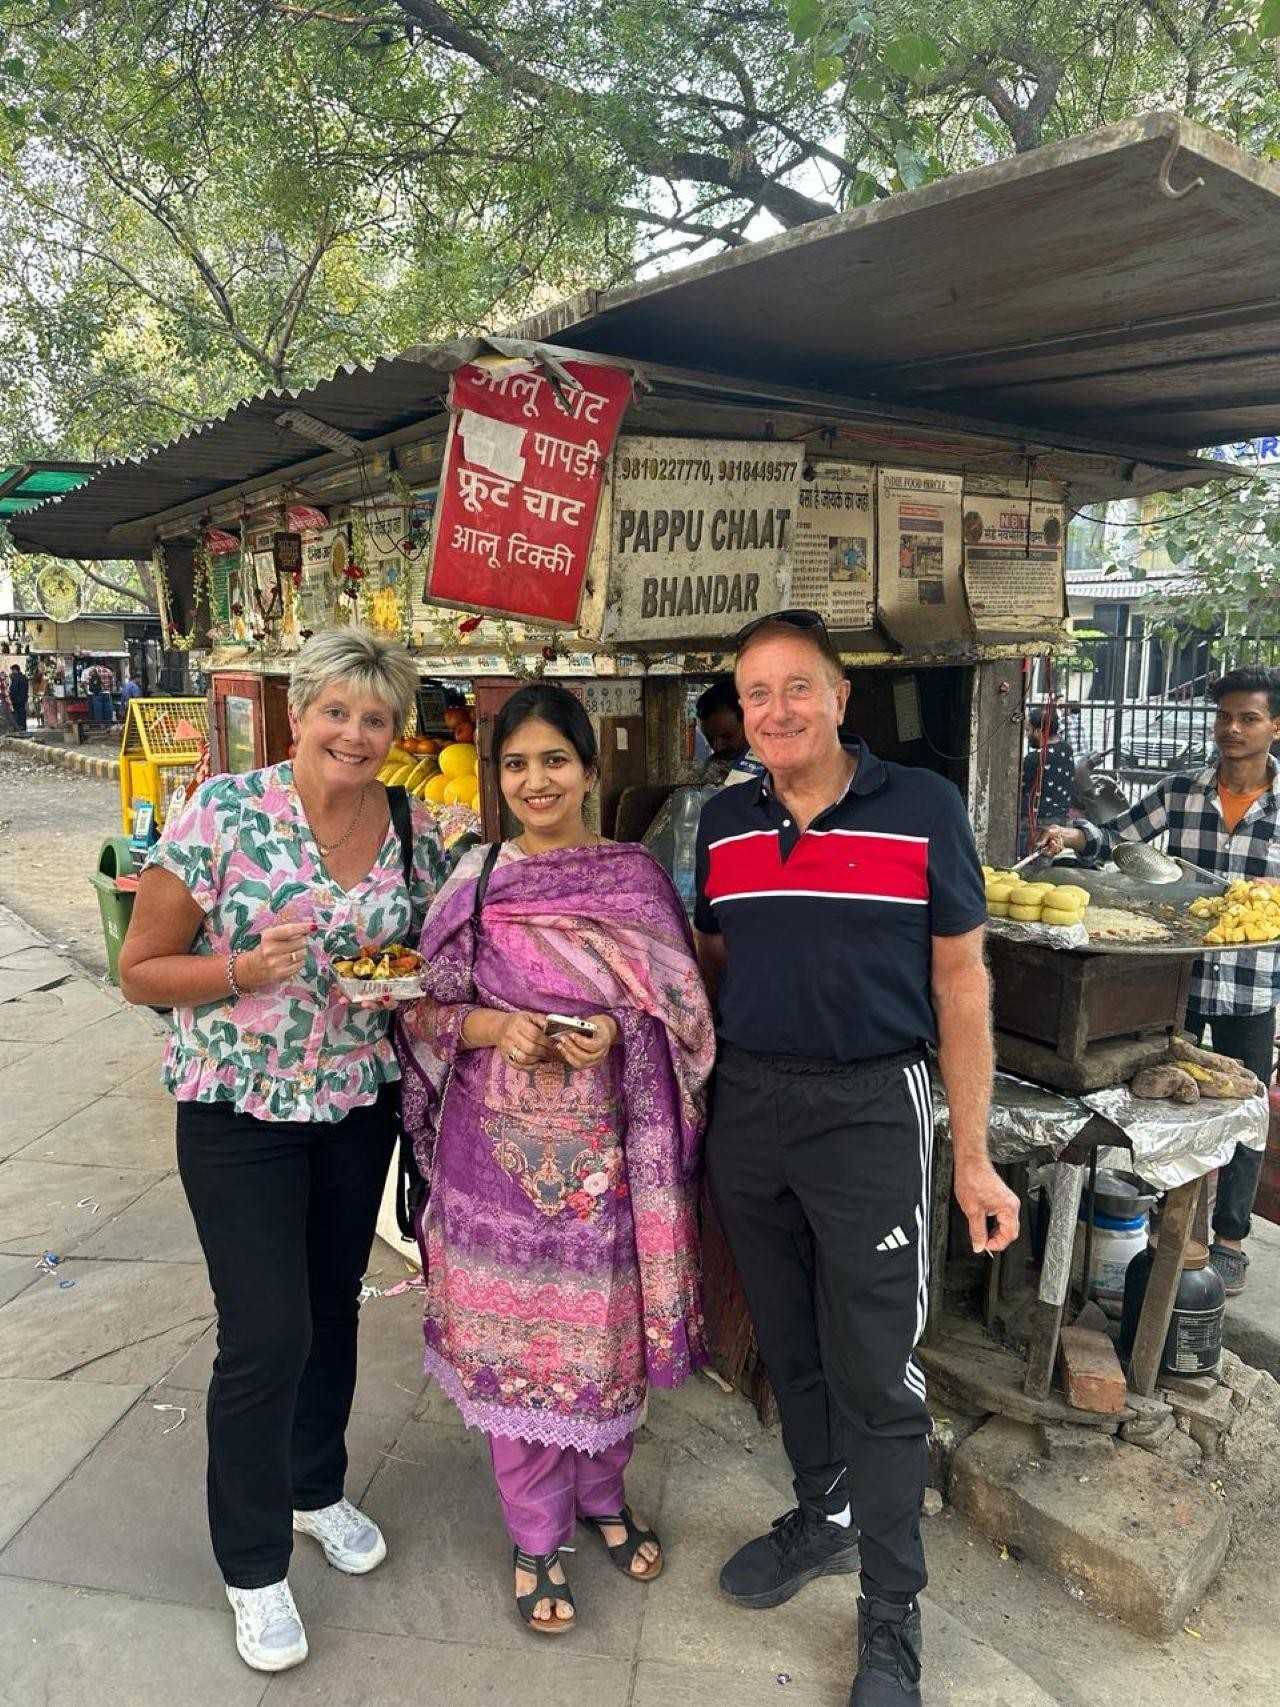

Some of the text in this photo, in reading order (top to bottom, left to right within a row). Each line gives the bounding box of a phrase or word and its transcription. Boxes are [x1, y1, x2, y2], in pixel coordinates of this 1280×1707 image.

[534, 438, 602, 482] पापड़ी
[621, 457, 714, 485] 9810227770,
[718, 460, 798, 482] 9818449577
[458, 467, 586, 526] फ्रूट चाट
[451, 524, 576, 576] आलू टिक्की
[618, 508, 791, 553] PAPPU CHAAT
[641, 572, 760, 619] BHANDAR
